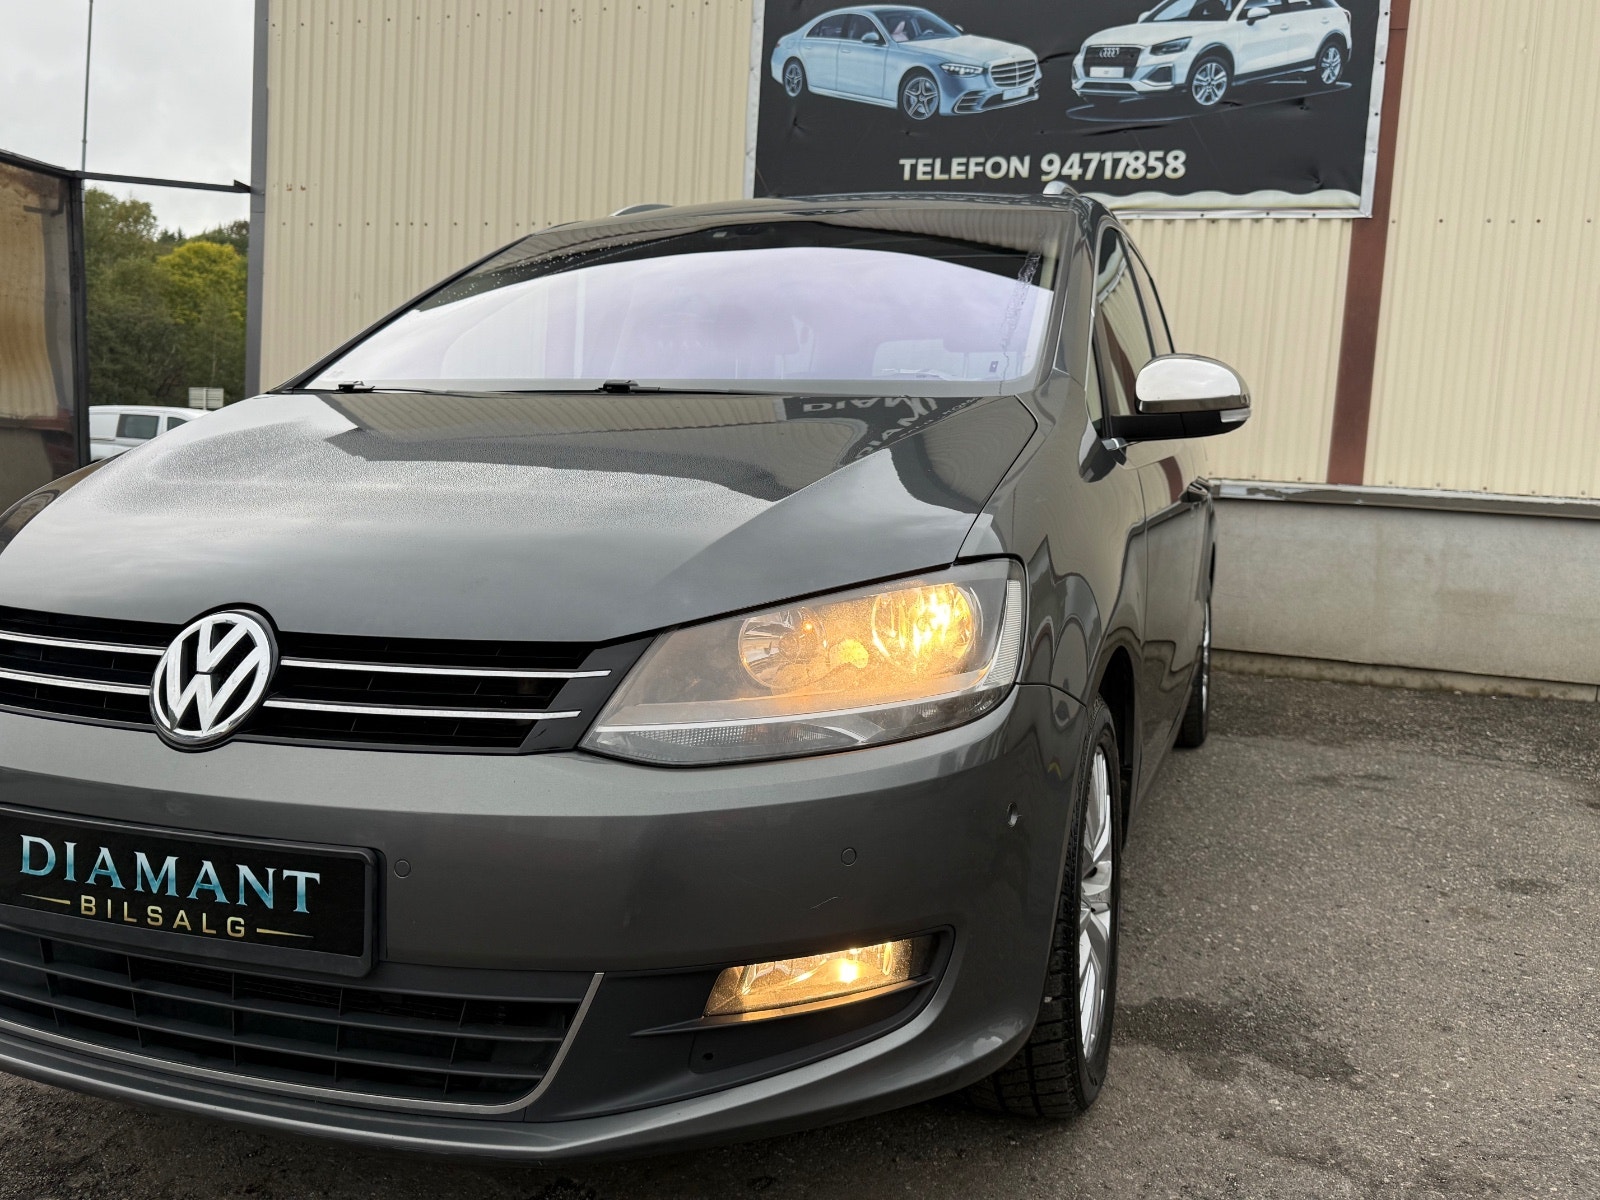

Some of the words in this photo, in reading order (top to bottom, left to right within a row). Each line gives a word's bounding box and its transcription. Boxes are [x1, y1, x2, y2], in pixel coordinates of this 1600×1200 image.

[899, 155, 1030, 181] TELEFON
[1040, 149, 1187, 181] 94717858
[158, 614, 270, 738] VW
[19, 834, 321, 914] DIAMANT
[80, 895, 246, 938] BILSALG
